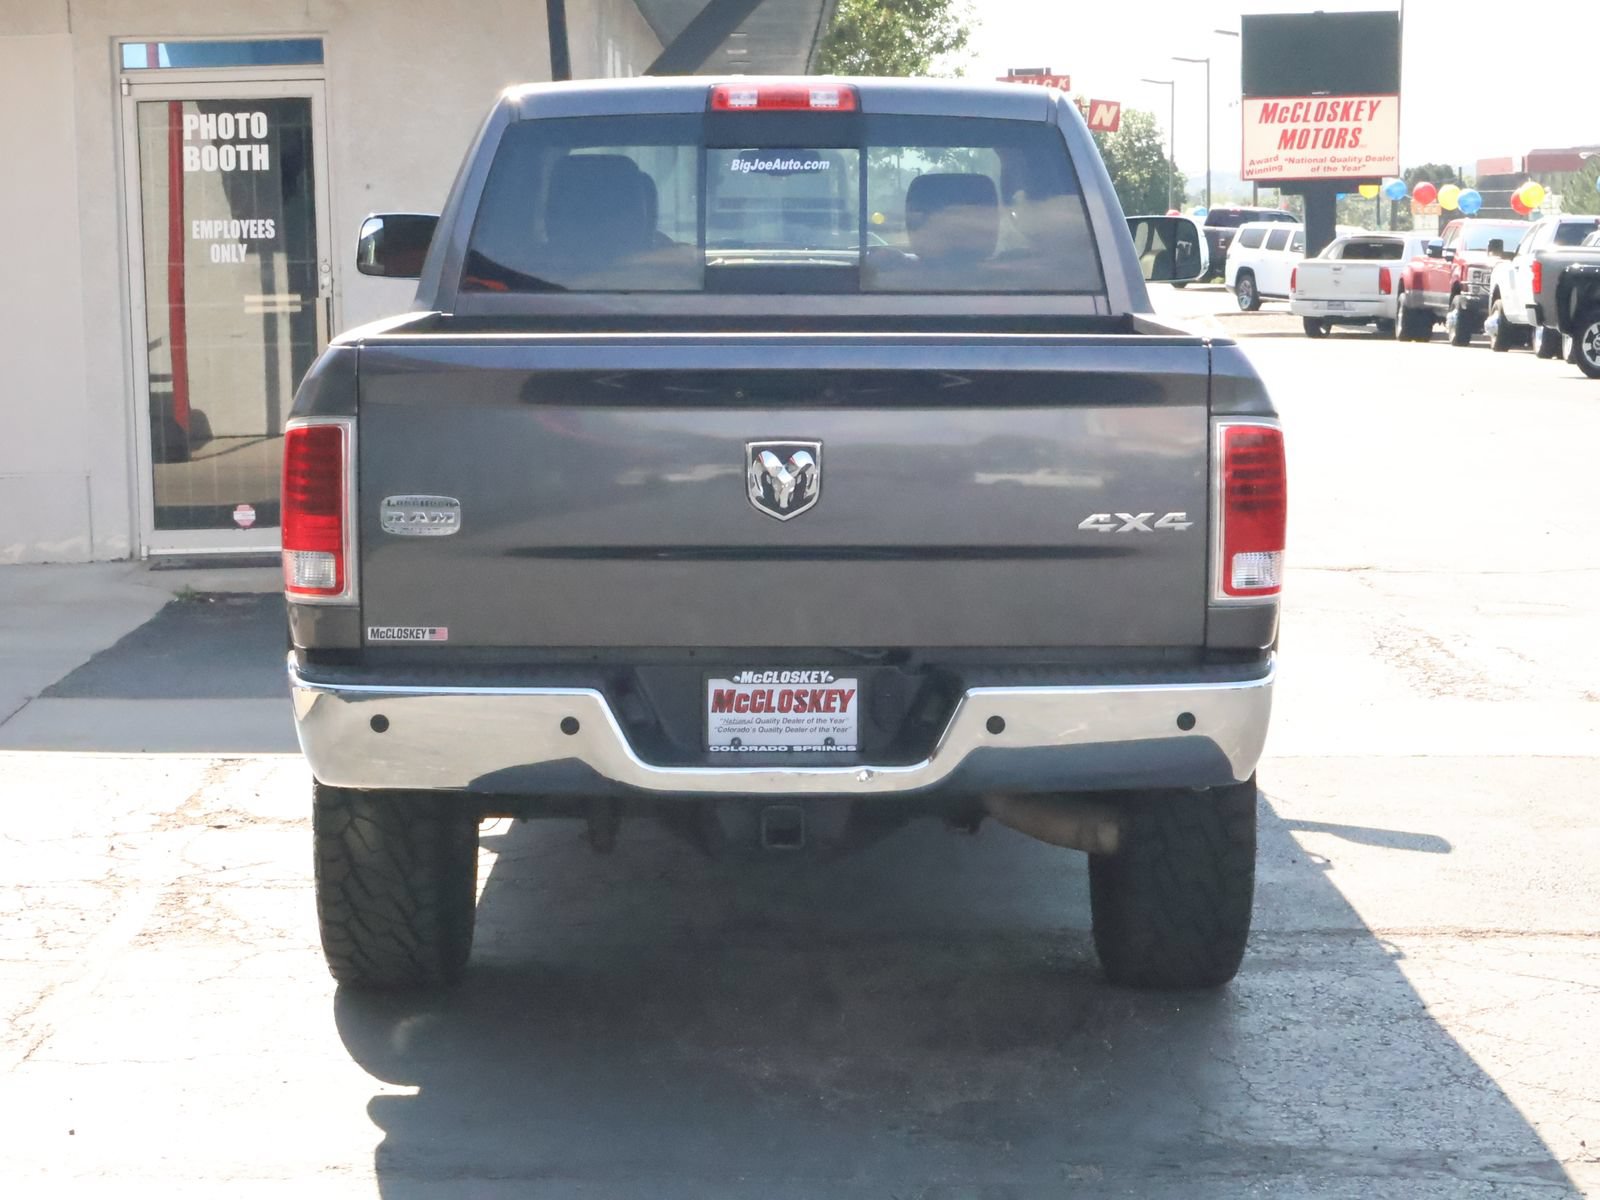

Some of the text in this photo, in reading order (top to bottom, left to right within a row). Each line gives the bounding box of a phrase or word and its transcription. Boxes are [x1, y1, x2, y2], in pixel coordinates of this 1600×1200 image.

[1258, 100, 1382, 124] McCLOSKEY
[183, 112, 268, 140] PHOTO
[1277, 127, 1363, 150] MOTORS
[183, 144, 270, 172] BOOTH
[1248, 155, 1279, 166] Award
[1329, 155, 1363, 164] Quality
[1365, 154, 1395, 163] Dealer
[731, 158, 830, 173] BigJoeAuto.com
[1245, 164, 1283, 176] Winning
[1323, 165, 1338, 173] the
[192, 219, 276, 239] EMPLOYEES
[210, 243, 248, 263] ONLY
[386, 511, 455, 524] RAM
[370, 628, 427, 640] McCLOSKEY
[740, 670, 830, 684] McCLOSKEY
[711, 689, 856, 713] McCLOSKEY
[755, 717, 780, 725] Quality
[758, 726, 784, 734] Quality
